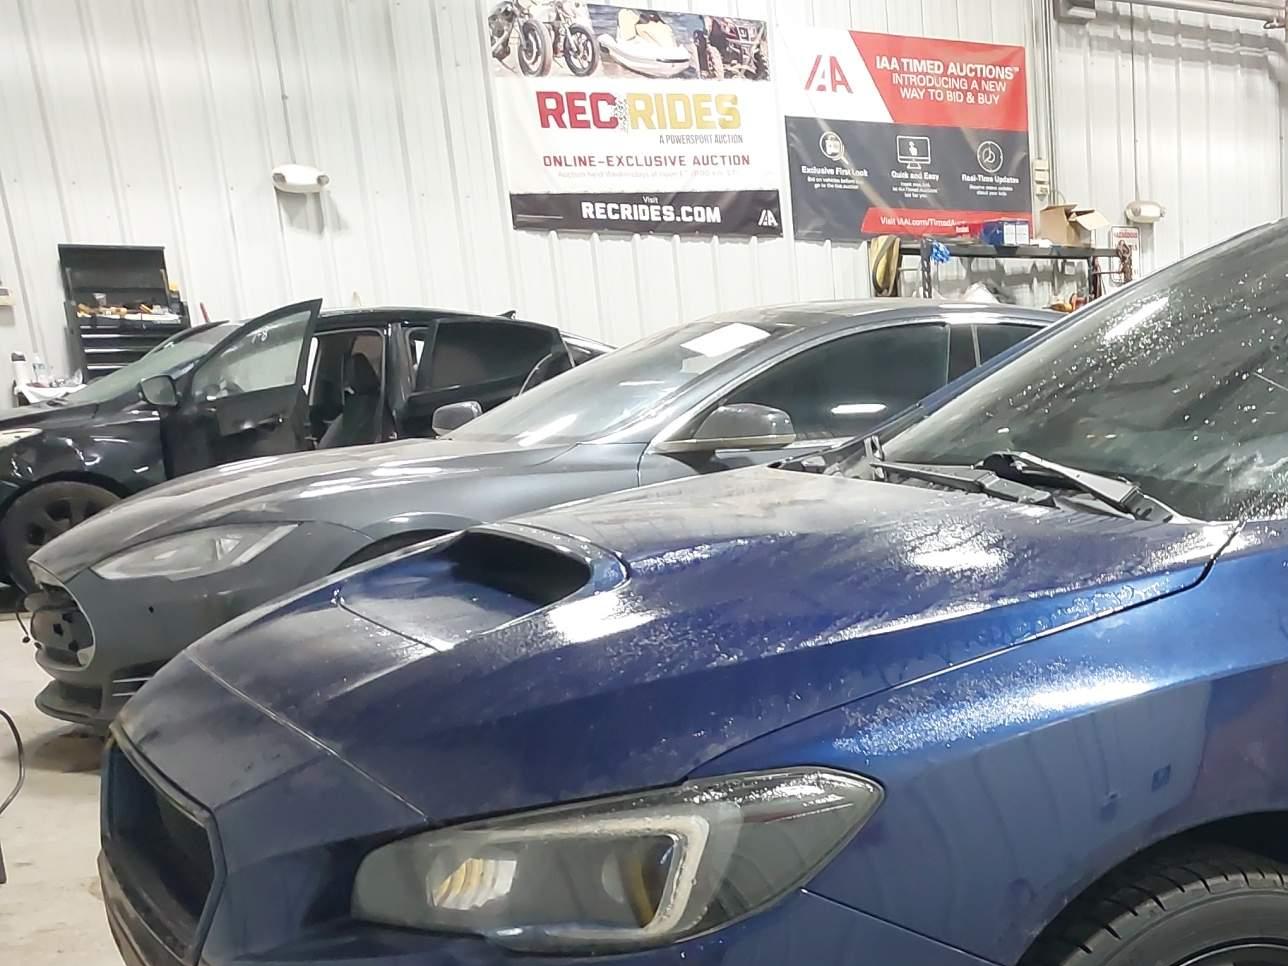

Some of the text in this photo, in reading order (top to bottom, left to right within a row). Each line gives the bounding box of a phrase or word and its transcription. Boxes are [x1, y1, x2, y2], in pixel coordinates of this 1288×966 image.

[876, 56, 899, 71] IAA
[901, 58, 943, 74] TIMED
[892, 73, 1006, 92] INTRODUCING A NEW
[900, 87, 1000, 105] WAY TO BID & BUY
[659, 134, 743, 145] A POWERSPORT AUCTION
[543, 155, 750, 167] ONLINE-EXCLUSIVE AUCTION
[801, 165, 834, 176] Exclusive
[891, 170, 940, 182] Quick and Easy
[994, 175, 1019, 184] Updates
[642, 195, 658, 204] Visit
[581, 201, 721, 223] RECRIDES.COM
[880, 216, 896, 226] Visit
